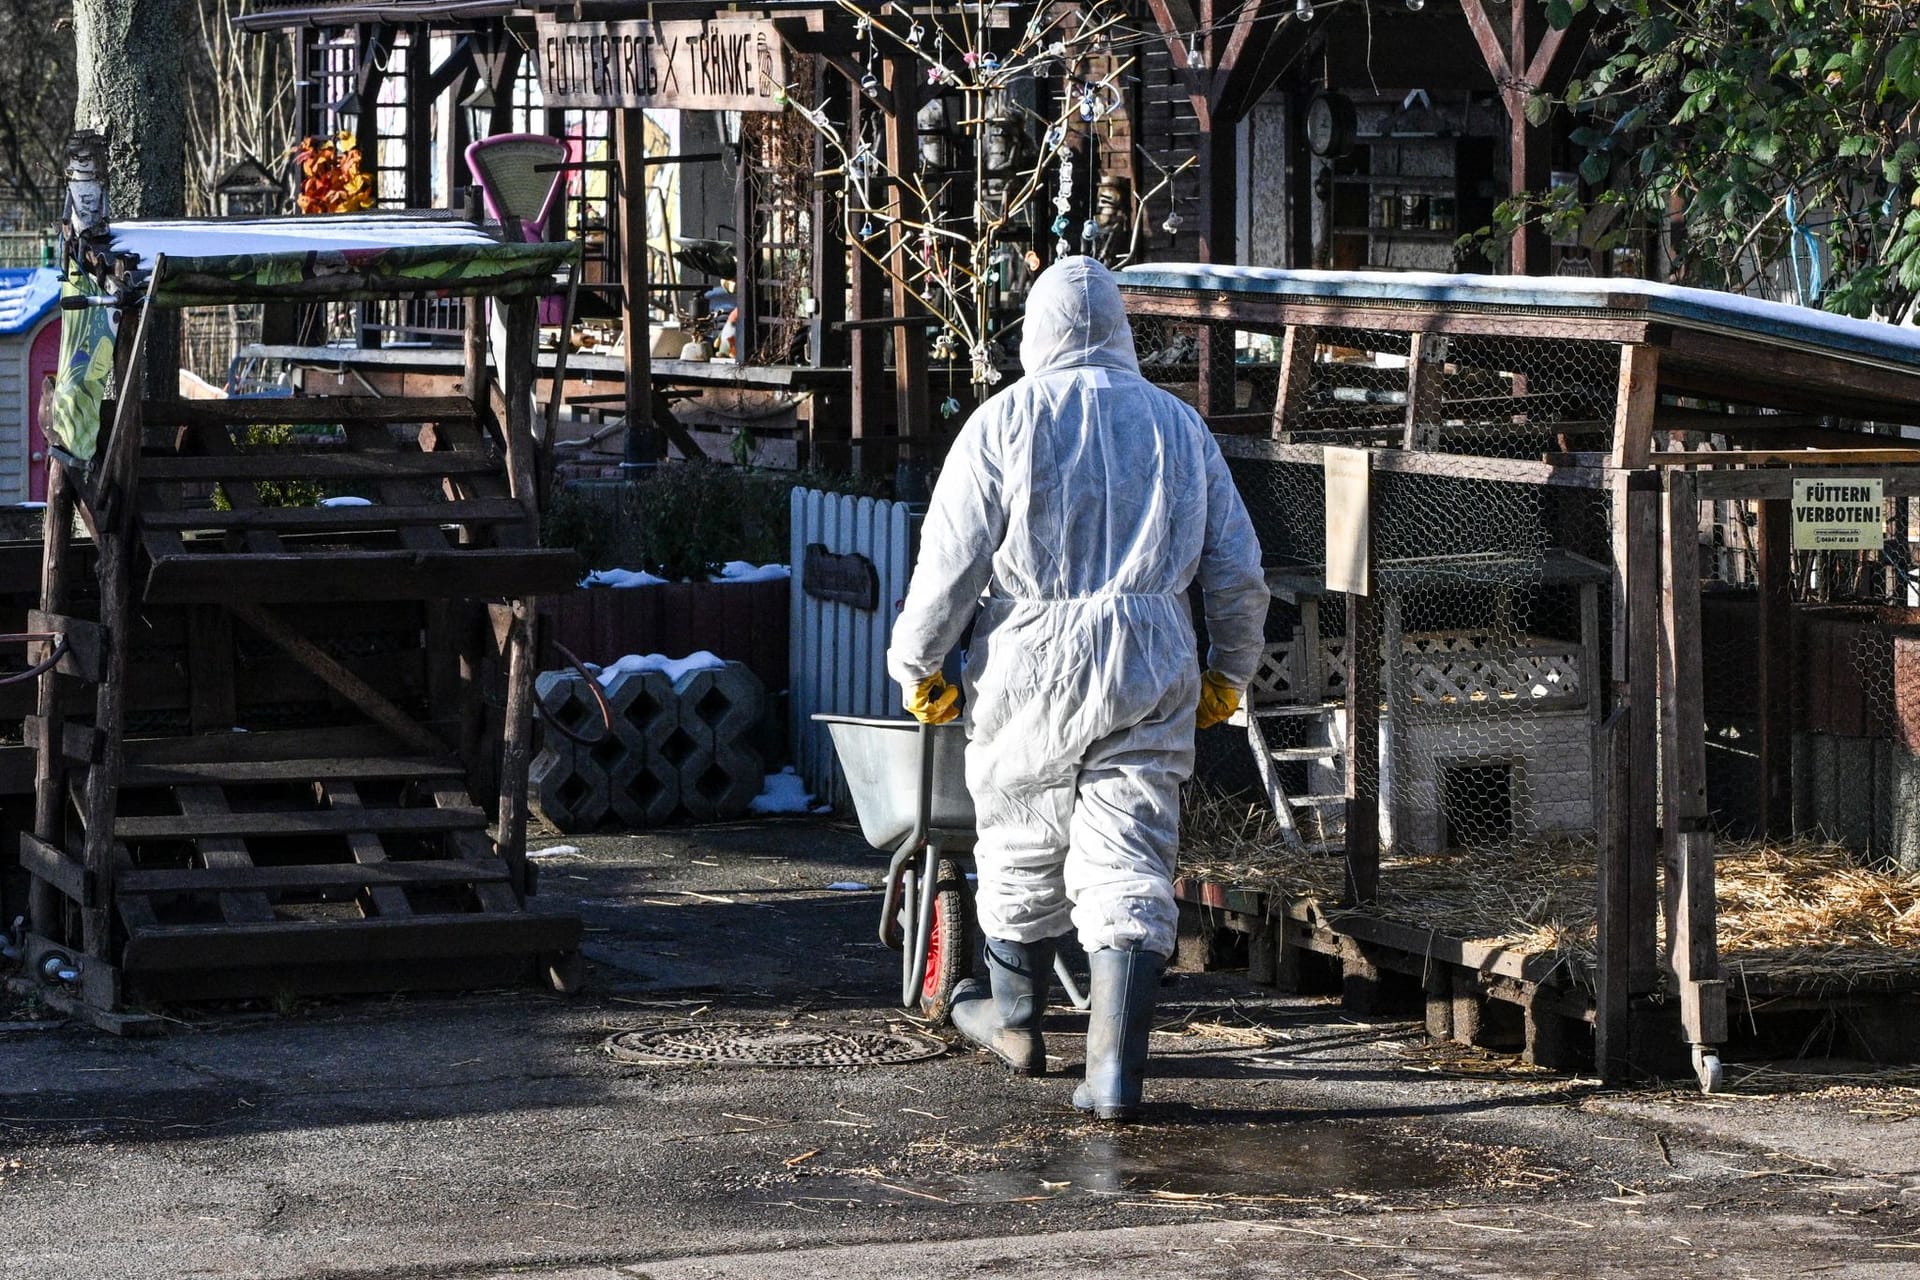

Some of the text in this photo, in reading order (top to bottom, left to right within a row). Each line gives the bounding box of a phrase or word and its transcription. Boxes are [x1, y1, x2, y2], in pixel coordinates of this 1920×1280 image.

[546, 35, 658, 96] FUTTERTROG
[685, 26, 755, 96] TRÄNKE
[1806, 482, 1870, 502] FÜTTERN
[1796, 506, 1881, 523] VERBOTEN!
